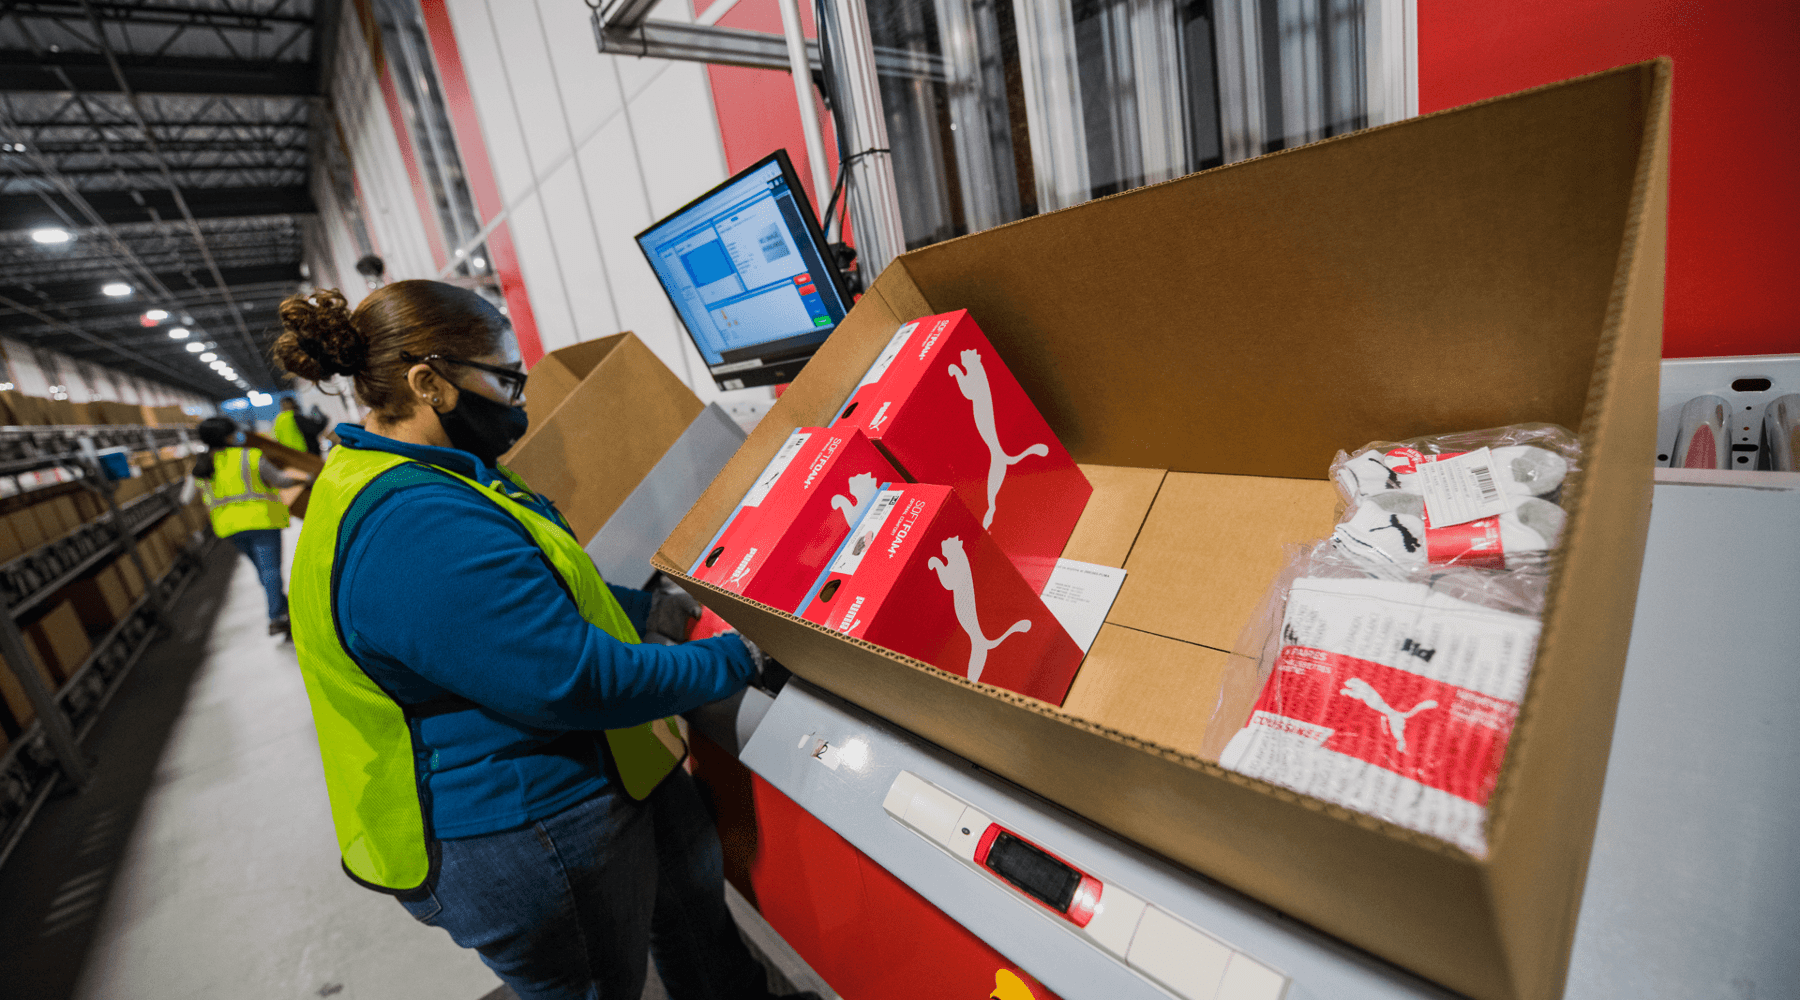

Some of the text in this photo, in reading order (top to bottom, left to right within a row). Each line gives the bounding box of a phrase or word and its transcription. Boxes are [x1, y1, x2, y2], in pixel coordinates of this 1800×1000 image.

[804, 437, 842, 490] SOFTFOAM+
[902, 498, 915, 515] OPTIMAL
[888, 500, 925, 559] SOFTFOAM+
[890, 516, 905, 536] COMFORT
[839, 596, 866, 630] PUMA
